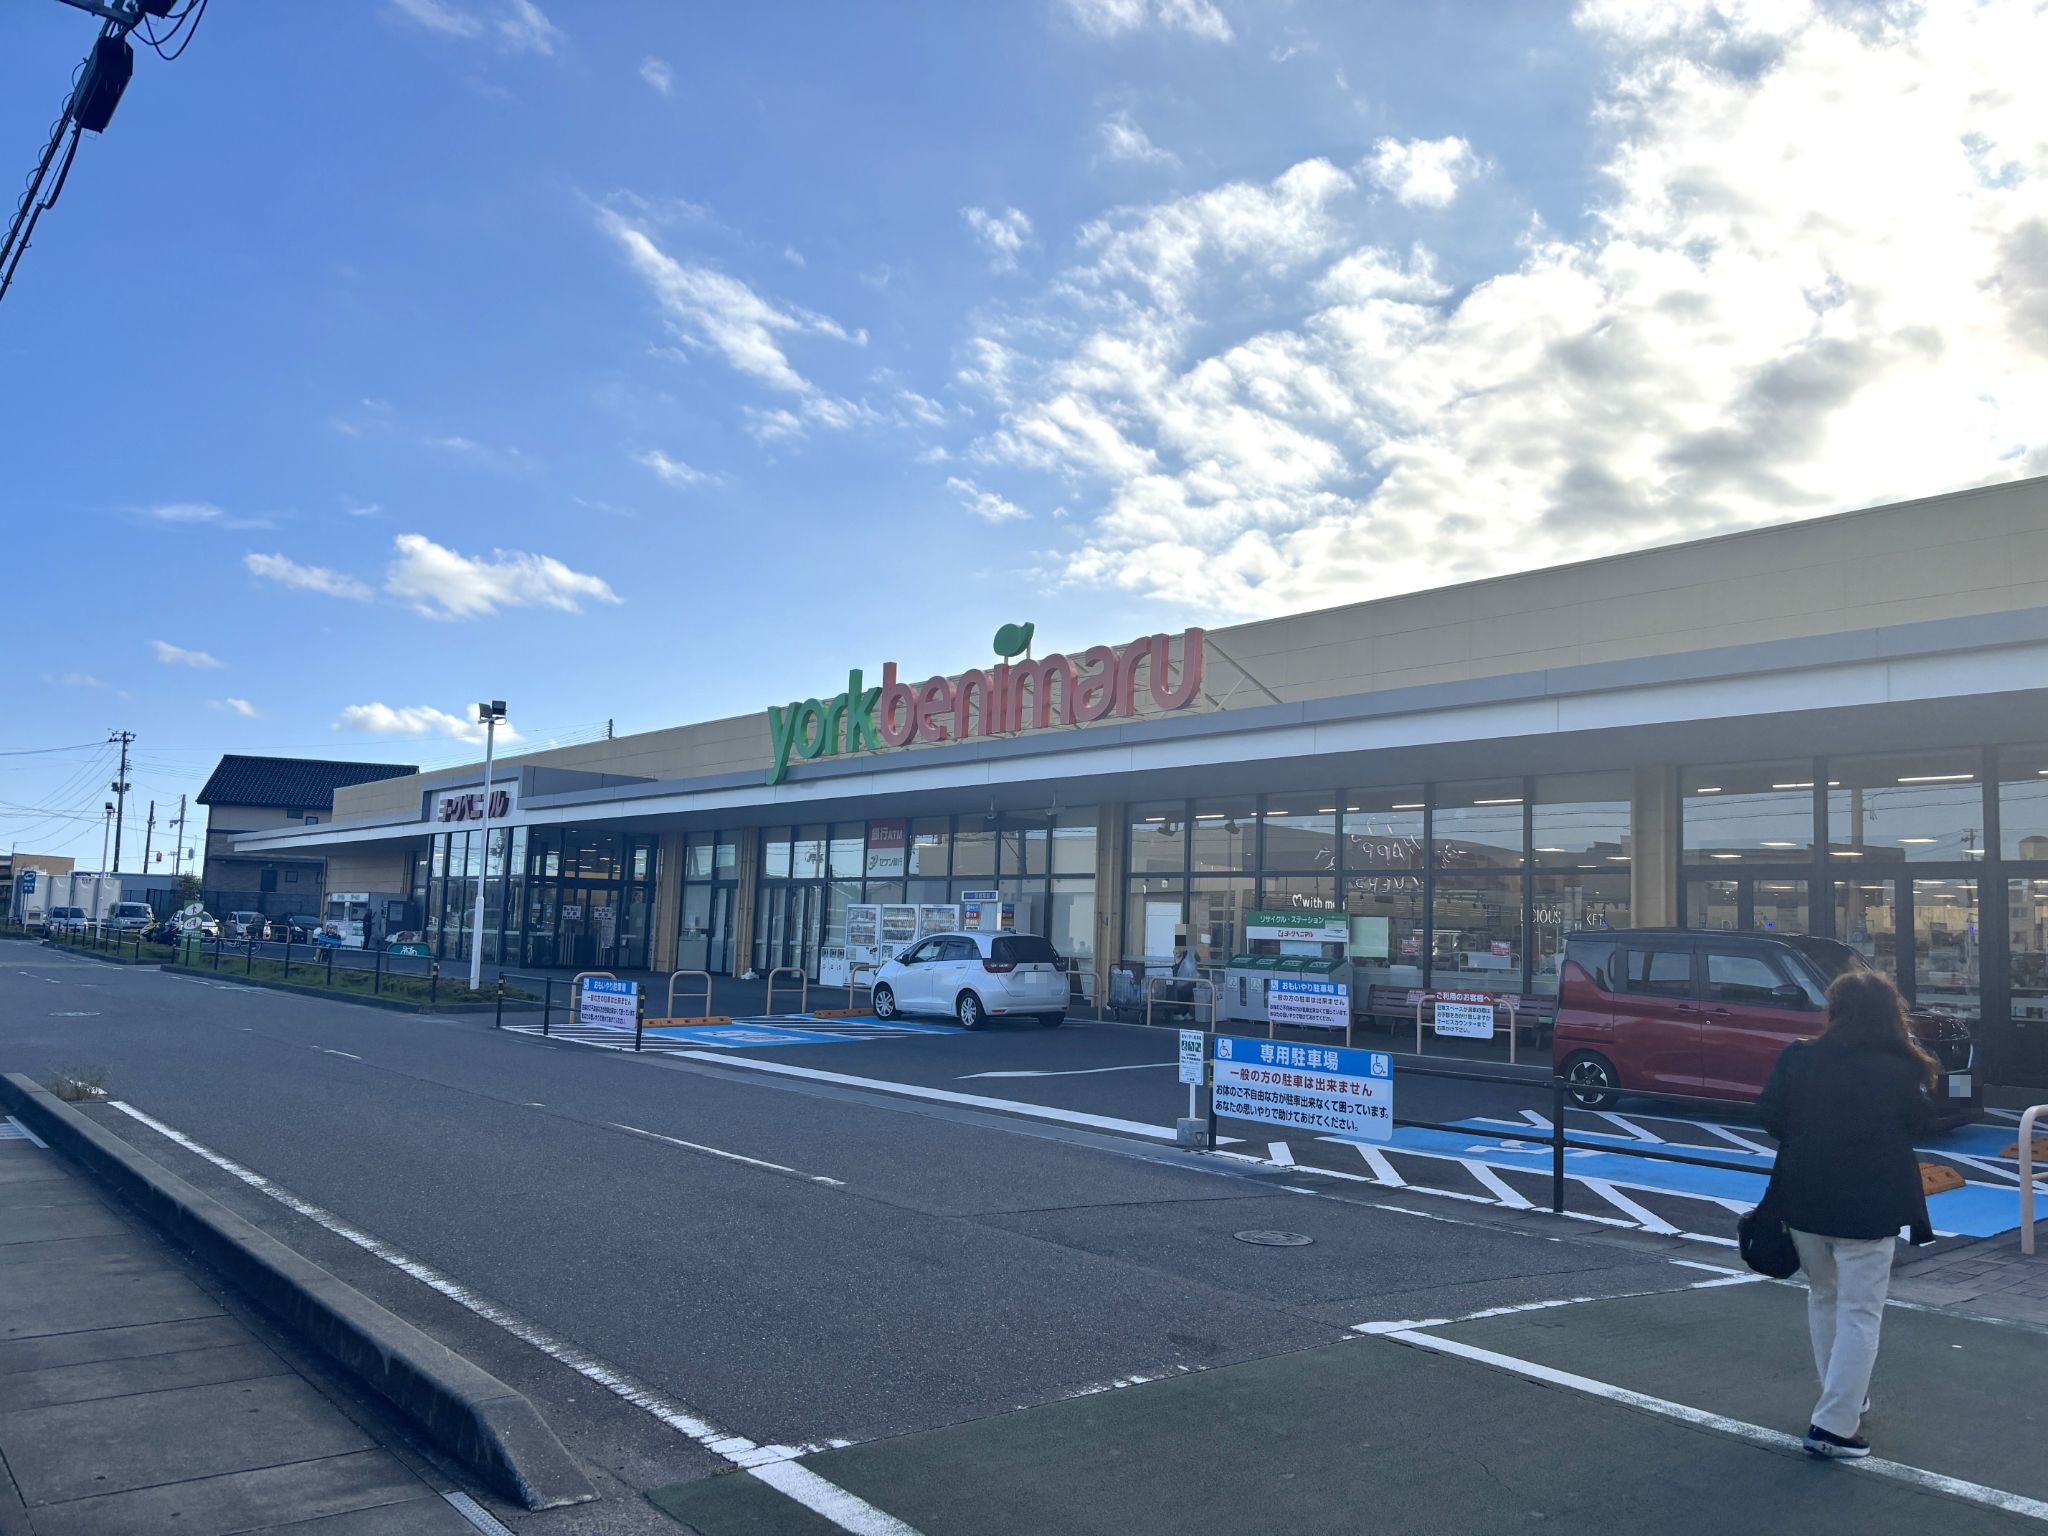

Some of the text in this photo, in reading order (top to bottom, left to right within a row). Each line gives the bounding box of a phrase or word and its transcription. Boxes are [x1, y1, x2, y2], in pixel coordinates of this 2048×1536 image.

[437, 791, 510, 822] ヨークベニル
[1302, 896, 1323, 909] with
[1260, 915, 1325, 925] リサイクル・ステーション
[1282, 982, 1335, 994] おもいやり駐車場
[1436, 991, 1491, 1002] ご利用のお客様へ
[1260, 1044, 1339, 1071] 専用駐車場
[1230, 1067, 1373, 1097] 一般の方の駐車は出来ません
[1216, 1084, 1389, 1119] お体のご不自由な方が駐車出来なくて困っています。
[1215, 1100, 1359, 1132] あなたの思いやりで助けてあげてください。
